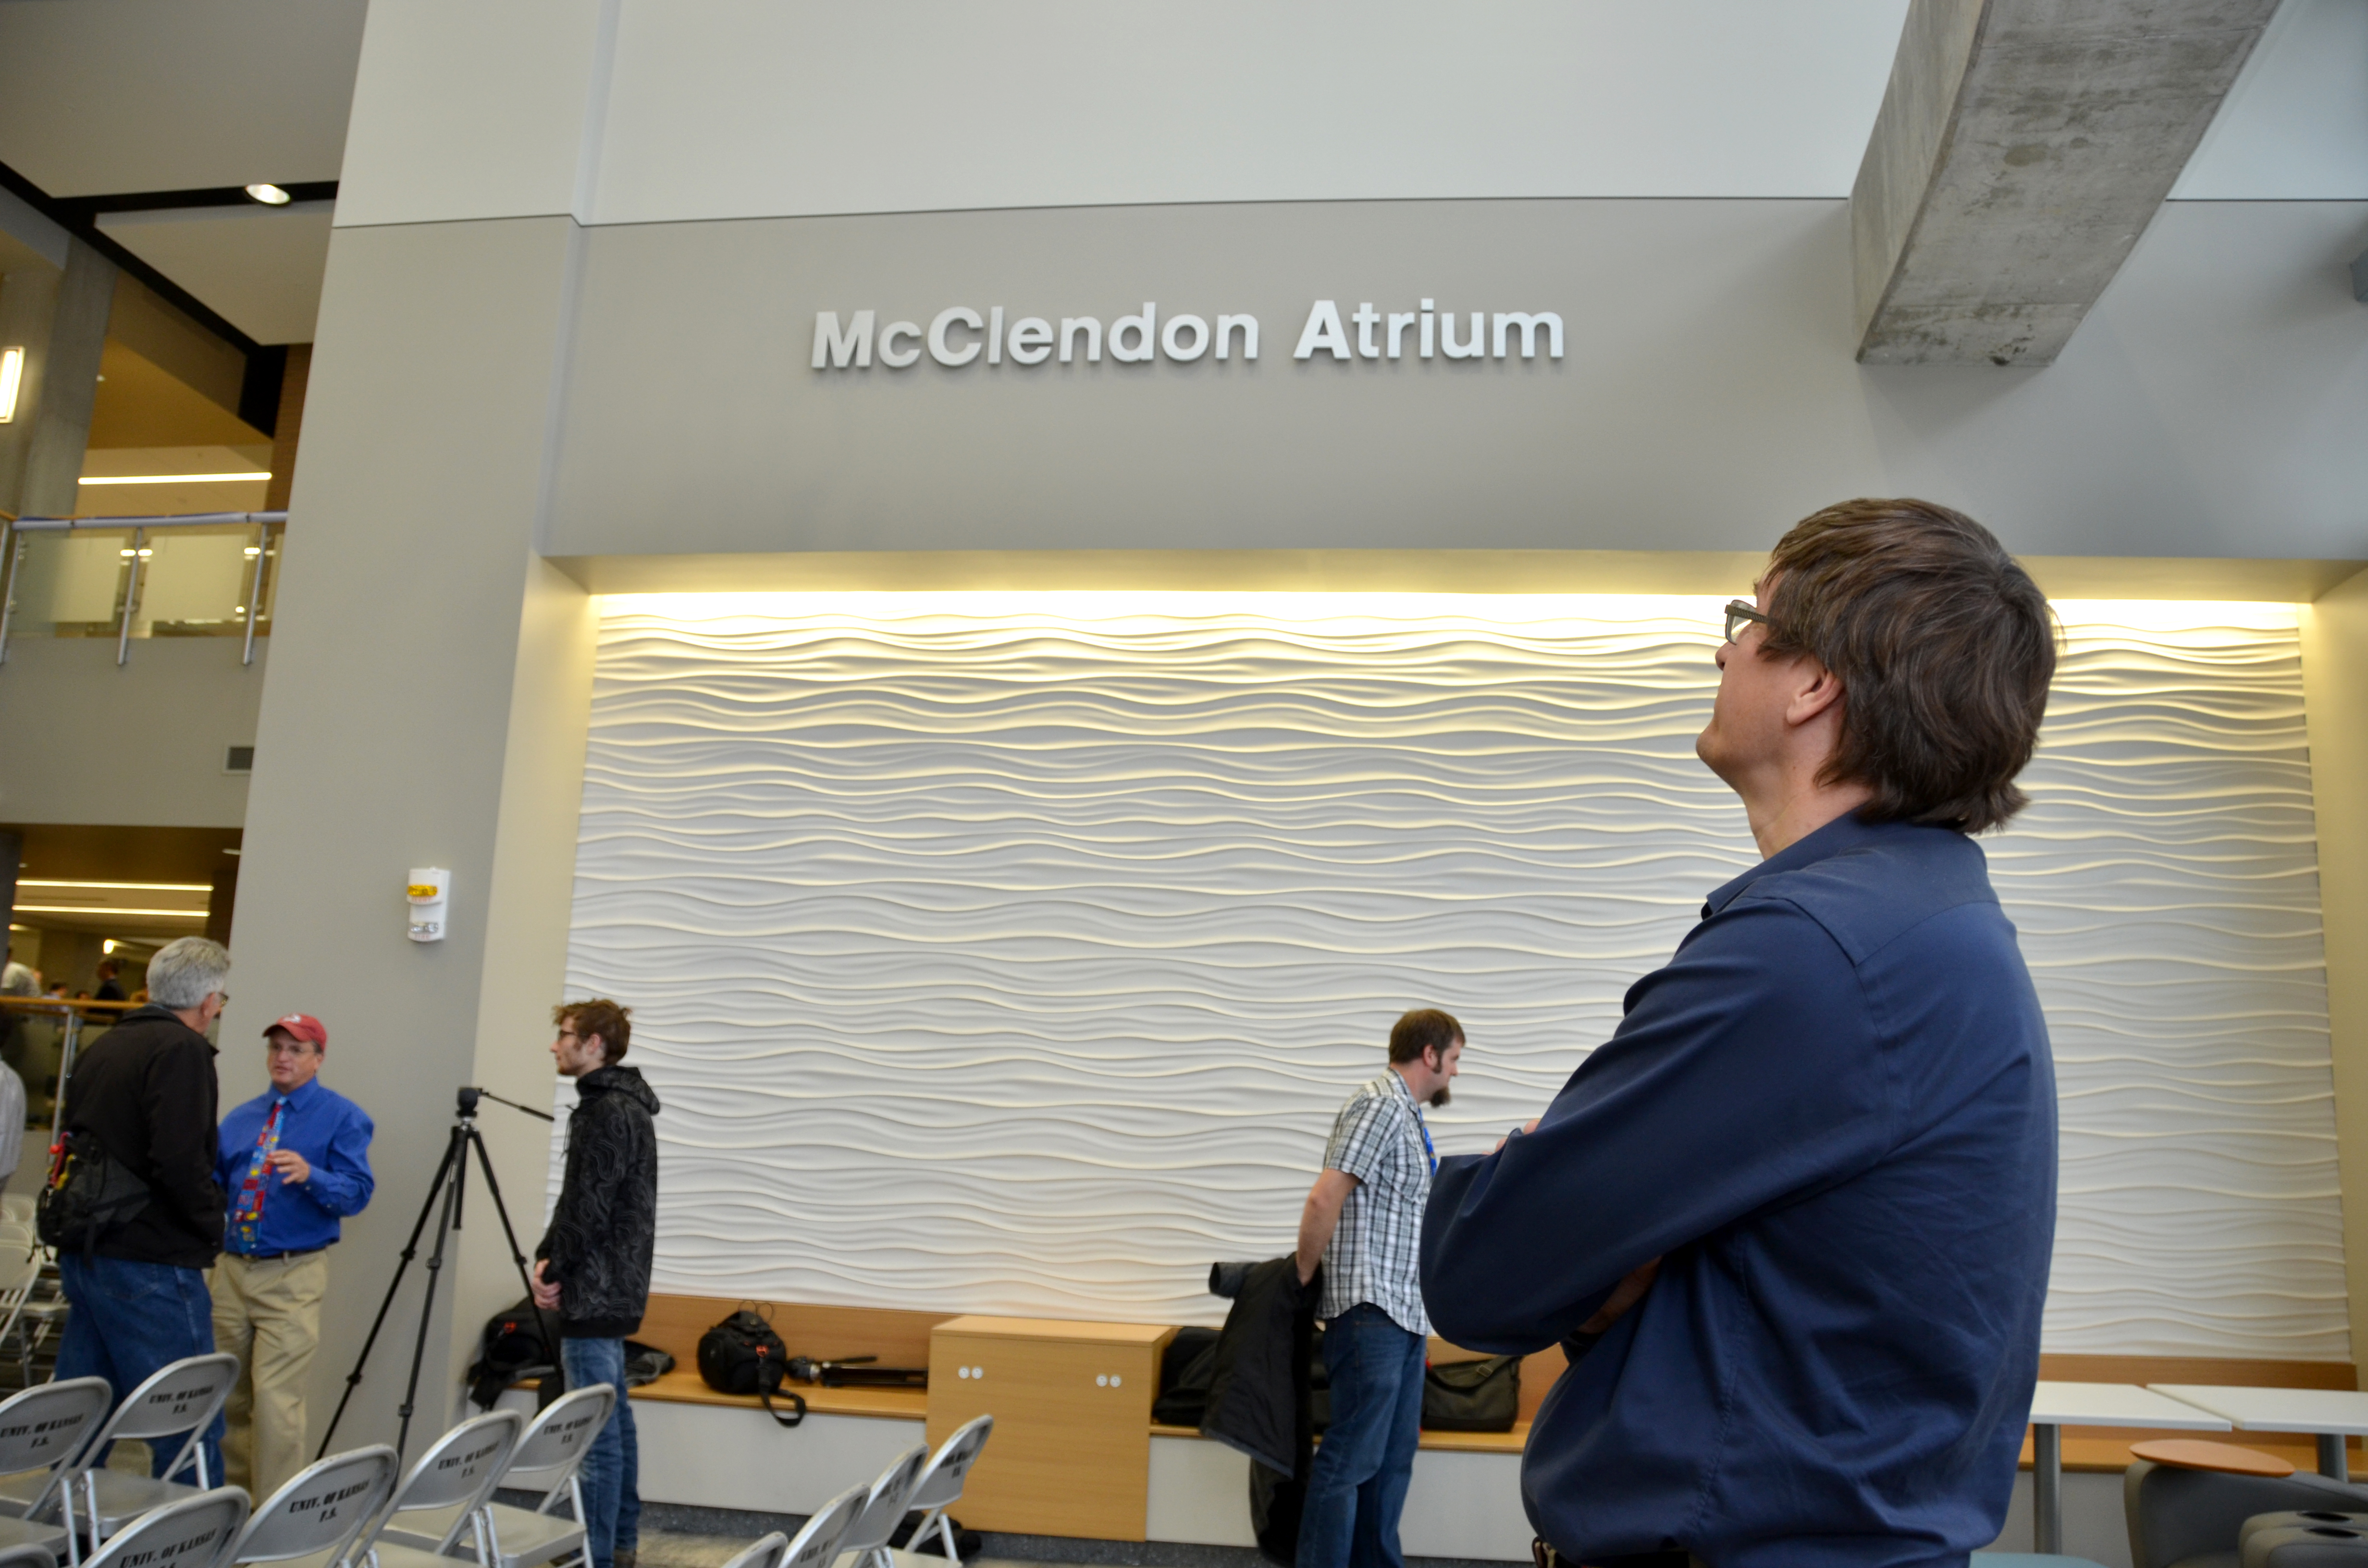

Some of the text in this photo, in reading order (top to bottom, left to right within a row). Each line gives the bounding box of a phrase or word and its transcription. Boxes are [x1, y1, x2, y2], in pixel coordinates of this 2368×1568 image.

[811, 298, 1564, 368] McClendon Atrium
[289, 1497, 320, 1513] UNIV.
[120, 1550, 157, 1568] UNIV.
[161, 1544, 177, 1559] OF
